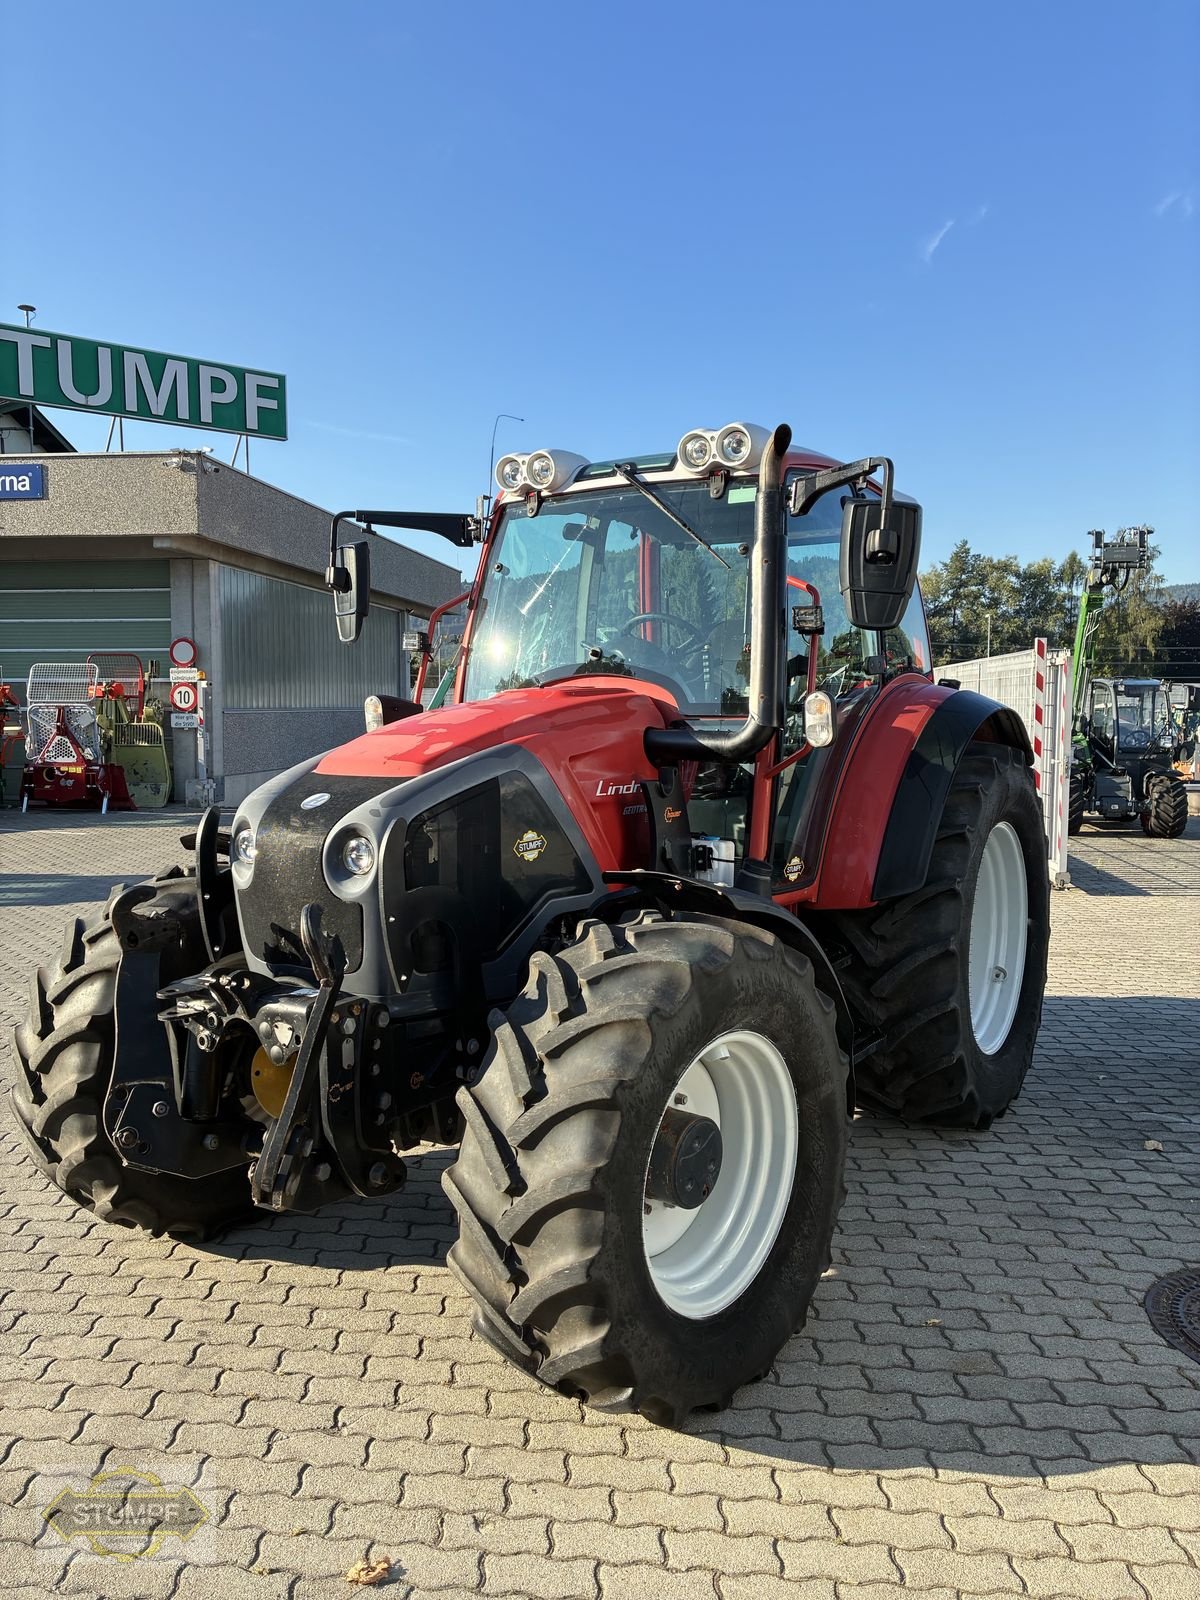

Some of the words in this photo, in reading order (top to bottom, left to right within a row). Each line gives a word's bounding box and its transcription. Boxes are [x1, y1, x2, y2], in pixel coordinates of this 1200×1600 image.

[0, 329, 279, 430] TUMPF
[177, 690, 190, 704] 10
[518, 840, 543, 852] STUMPF
